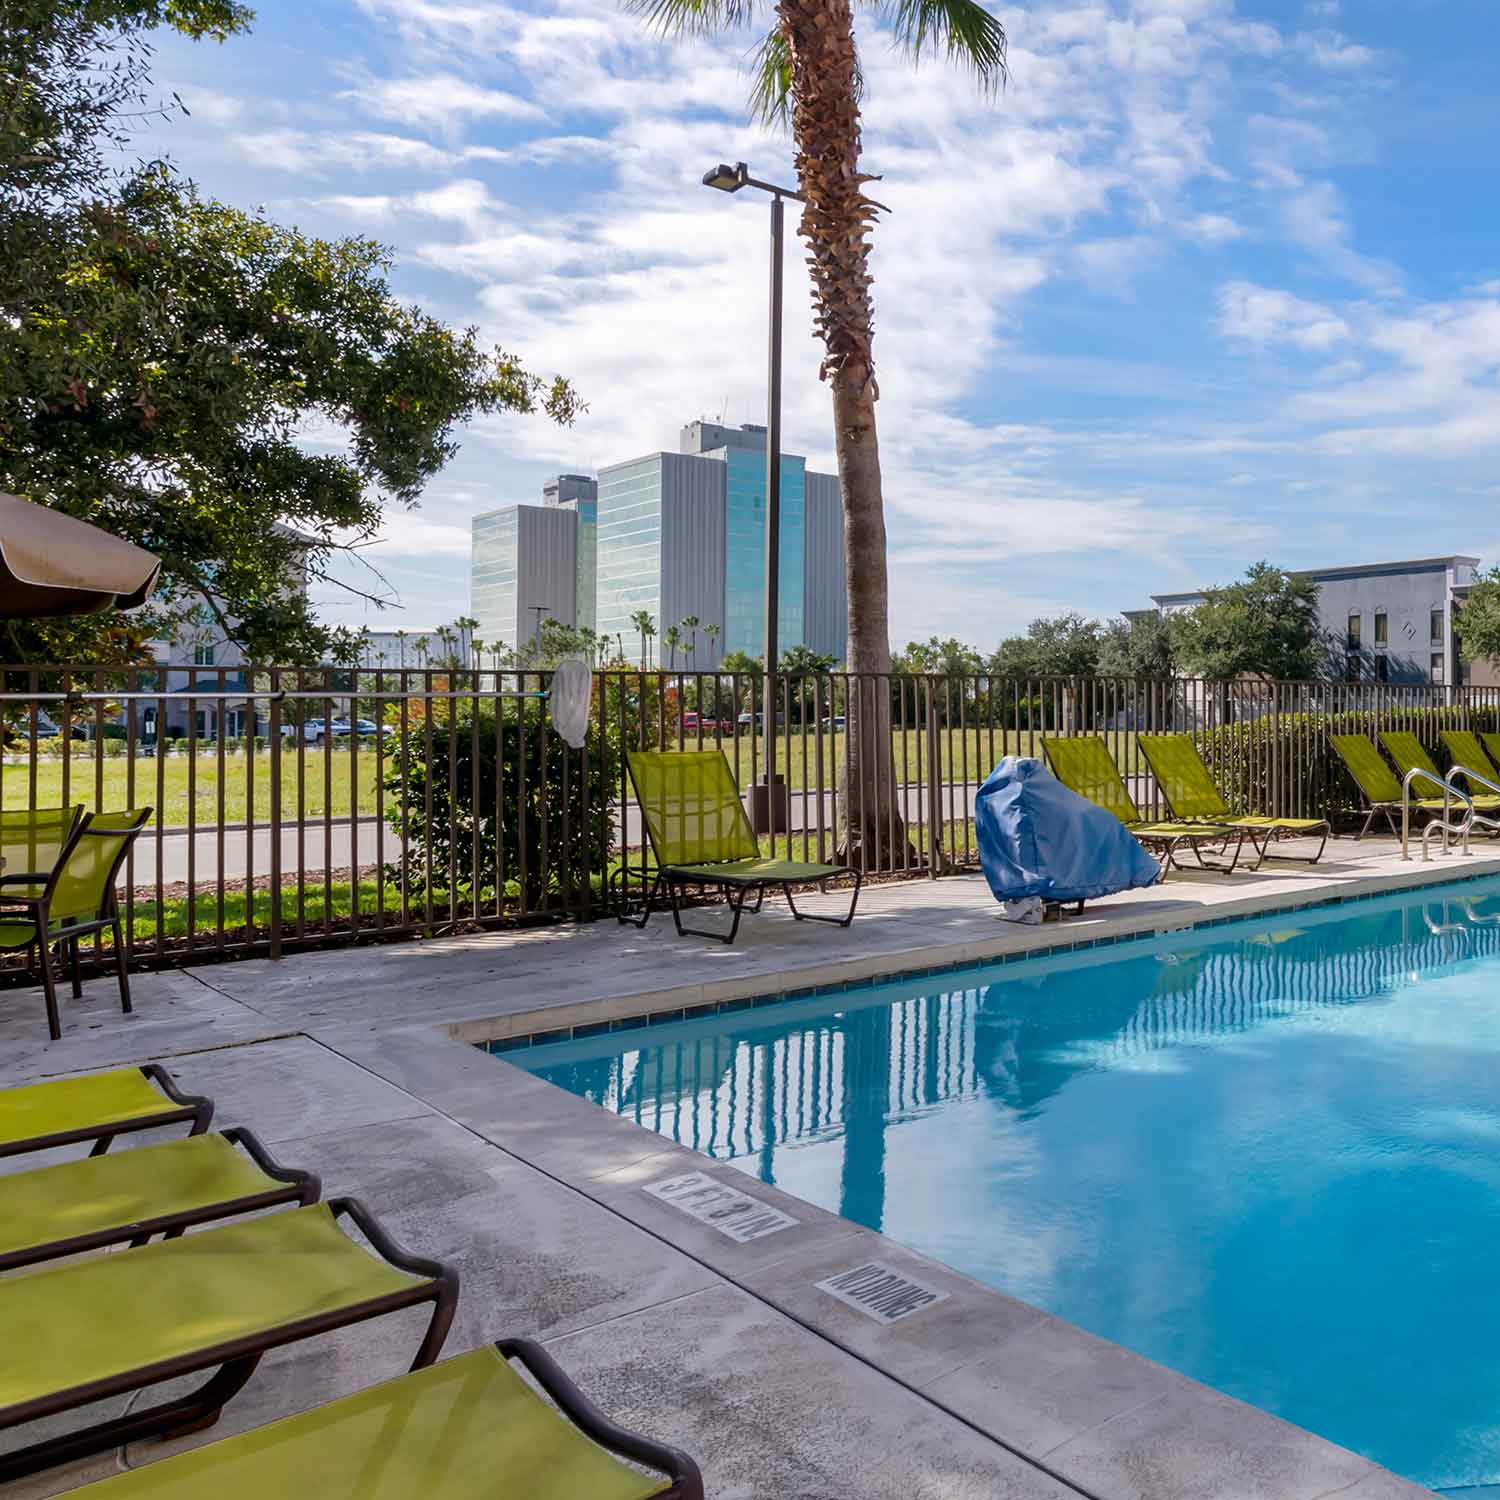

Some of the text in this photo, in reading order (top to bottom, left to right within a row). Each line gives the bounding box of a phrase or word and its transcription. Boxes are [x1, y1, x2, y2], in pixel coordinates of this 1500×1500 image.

[659, 1178, 702, 1192] 3
[708, 1202, 753, 1218] 3
[727, 1212, 786, 1237] IN
[847, 1274, 937, 1318] DIVING
